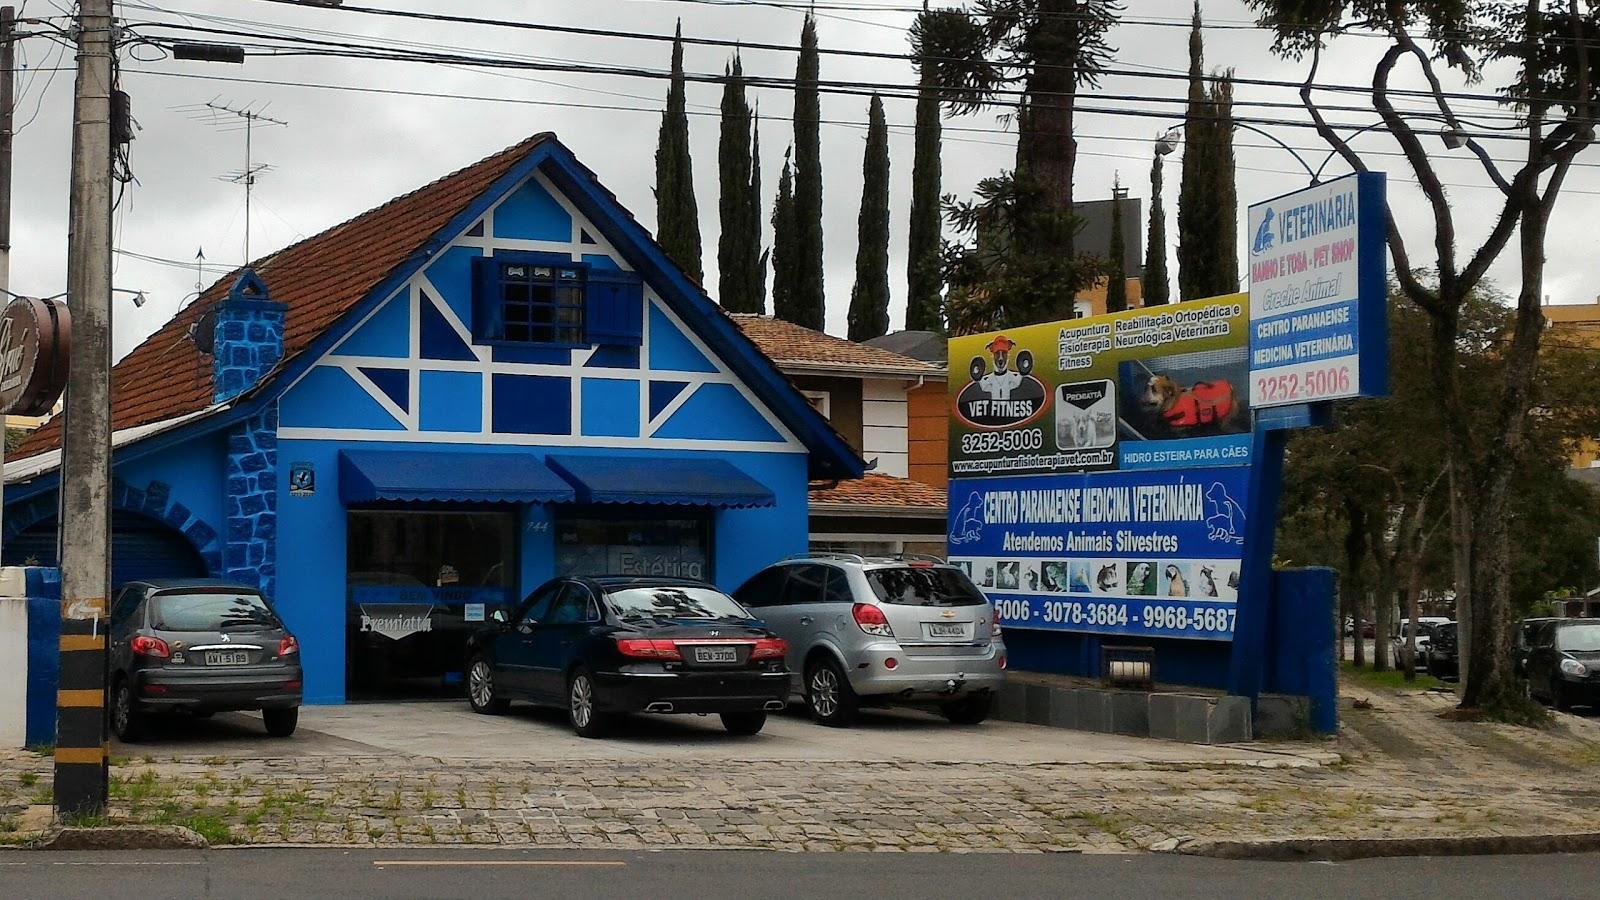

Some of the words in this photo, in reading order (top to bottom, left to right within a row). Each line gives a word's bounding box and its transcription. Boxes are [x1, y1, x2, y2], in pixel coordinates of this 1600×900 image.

[1279, 189, 1355, 244] VETERINÁRIA
[1279, 255, 1285, 277] E
[1314, 244, 1330, 269] PET
[1332, 238, 1355, 265] SHOP
[1262, 282, 1300, 310] Creche
[1300, 272, 1342, 303] Animal
[1115, 314, 1173, 332] Reabilitação
[1175, 305, 1231, 324] Ortopédica
[1233, 304, 1240, 315] e
[1257, 318, 1289, 339] CENTRO
[1292, 306, 1350, 332] PARANAENSE
[1059, 324, 1110, 340] Acupuntura
[1115, 330, 1172, 347] Neurológica
[1174, 321, 1229, 339] Veterinária
[1059, 338, 1110, 354] Fisioterapia
[1254, 343, 1293, 364] MEDICINA
[1294, 332, 1353, 358] VETERINÁRIA
[1059, 356, 1091, 369] Fitness
[1258, 366, 1350, 401] 3252-5006
[969, 400, 988, 418] VET
[991, 399, 1033, 418] FITNESS
[962, 430, 1042, 452] 3252-5006
[1124, 452, 1151, 464] HIDRO
[1153, 449, 1192, 462] ESTEIRA
[1193, 447, 1219, 460] PARA
[1221, 444, 1249, 458] CÃES
[953, 450, 1113, 472] www.acupunturafisioterapiavet.com.br
[984, 491, 1018, 524] CENTRO
[1020, 488, 1081, 524] PARANAENSE
[1082, 486, 1131, 523] MEDICINA
[1132, 475, 1204, 522] VETERINÁRIA
[1003, 531, 1064, 551] Atendemos
[1066, 530, 1113, 551] Animais
[1115, 530, 1178, 552] Silvestres
[360, 614, 433, 633] Premiatta
[1043, 601, 1128, 627] 3078-3684
[1143, 605, 1237, 632] 9968-5687
